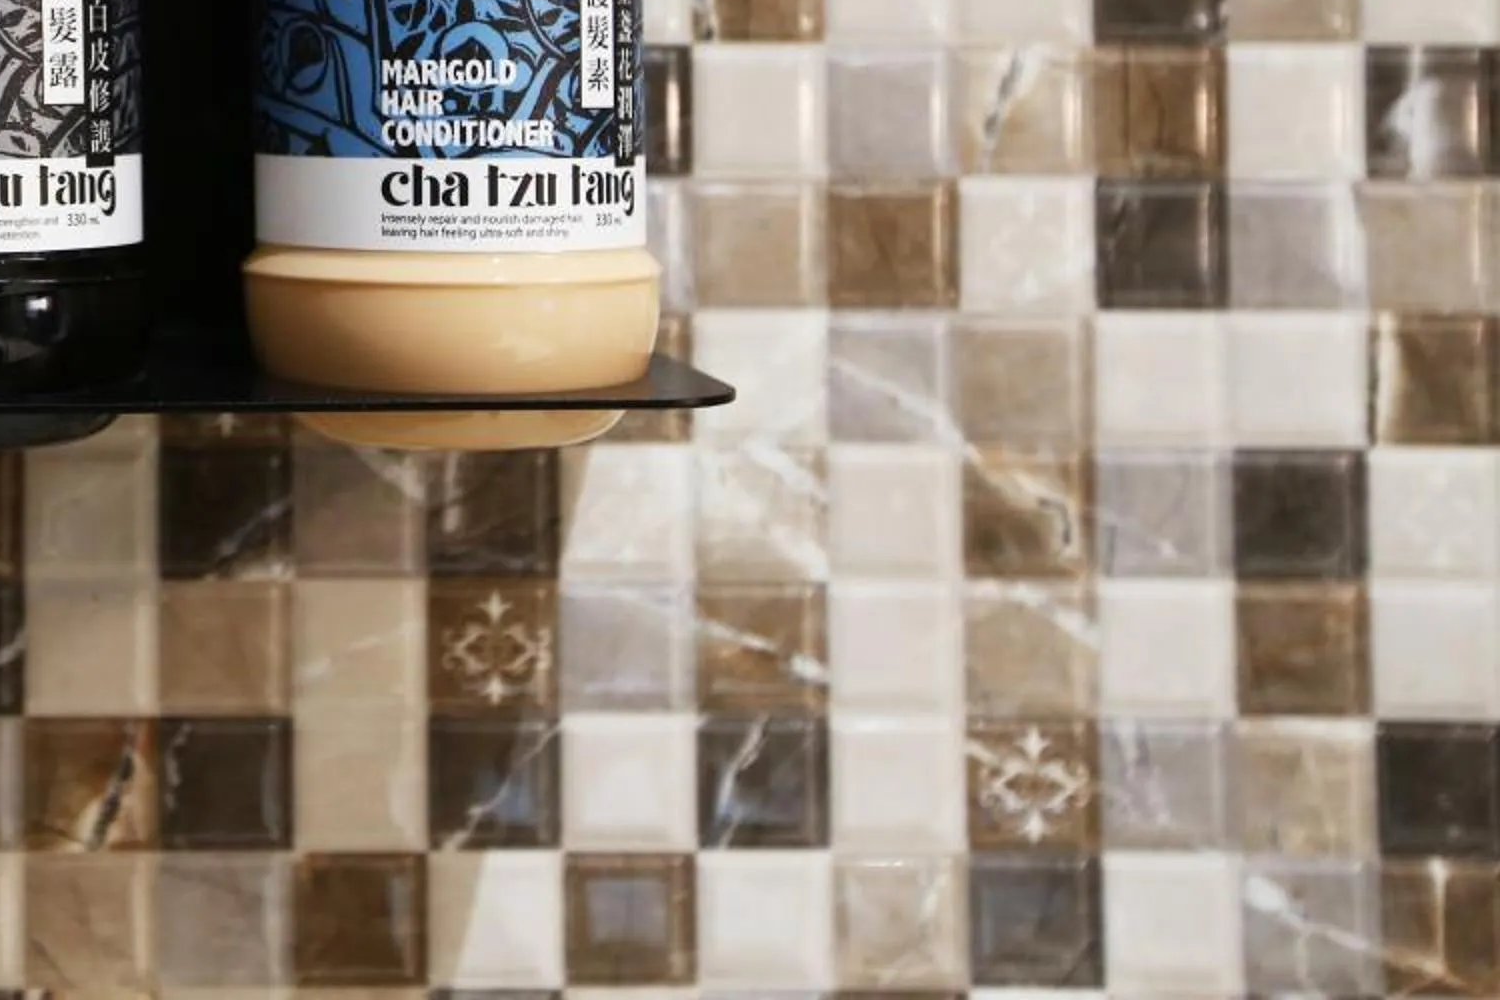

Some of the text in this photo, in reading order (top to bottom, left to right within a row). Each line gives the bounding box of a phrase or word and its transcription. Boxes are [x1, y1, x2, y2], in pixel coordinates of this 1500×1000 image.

[381, 58, 517, 86] MARIGOLD
[381, 89, 445, 116] HAIR
[381, 119, 555, 148] CONDITIONER
[381, 164, 469, 207] cha
[67, 213, 87, 227] 330
[381, 213, 426, 226] Intensely
[428, 213, 460, 226] repair
[461, 213, 481, 225] and
[482, 213, 519, 225] nourish
[521, 213, 565, 227] damaged
[596, 213, 612, 227] 330
[419, 226, 439, 238] hair
[441, 226, 477, 240] feeling
[525, 226, 545, 238] and
